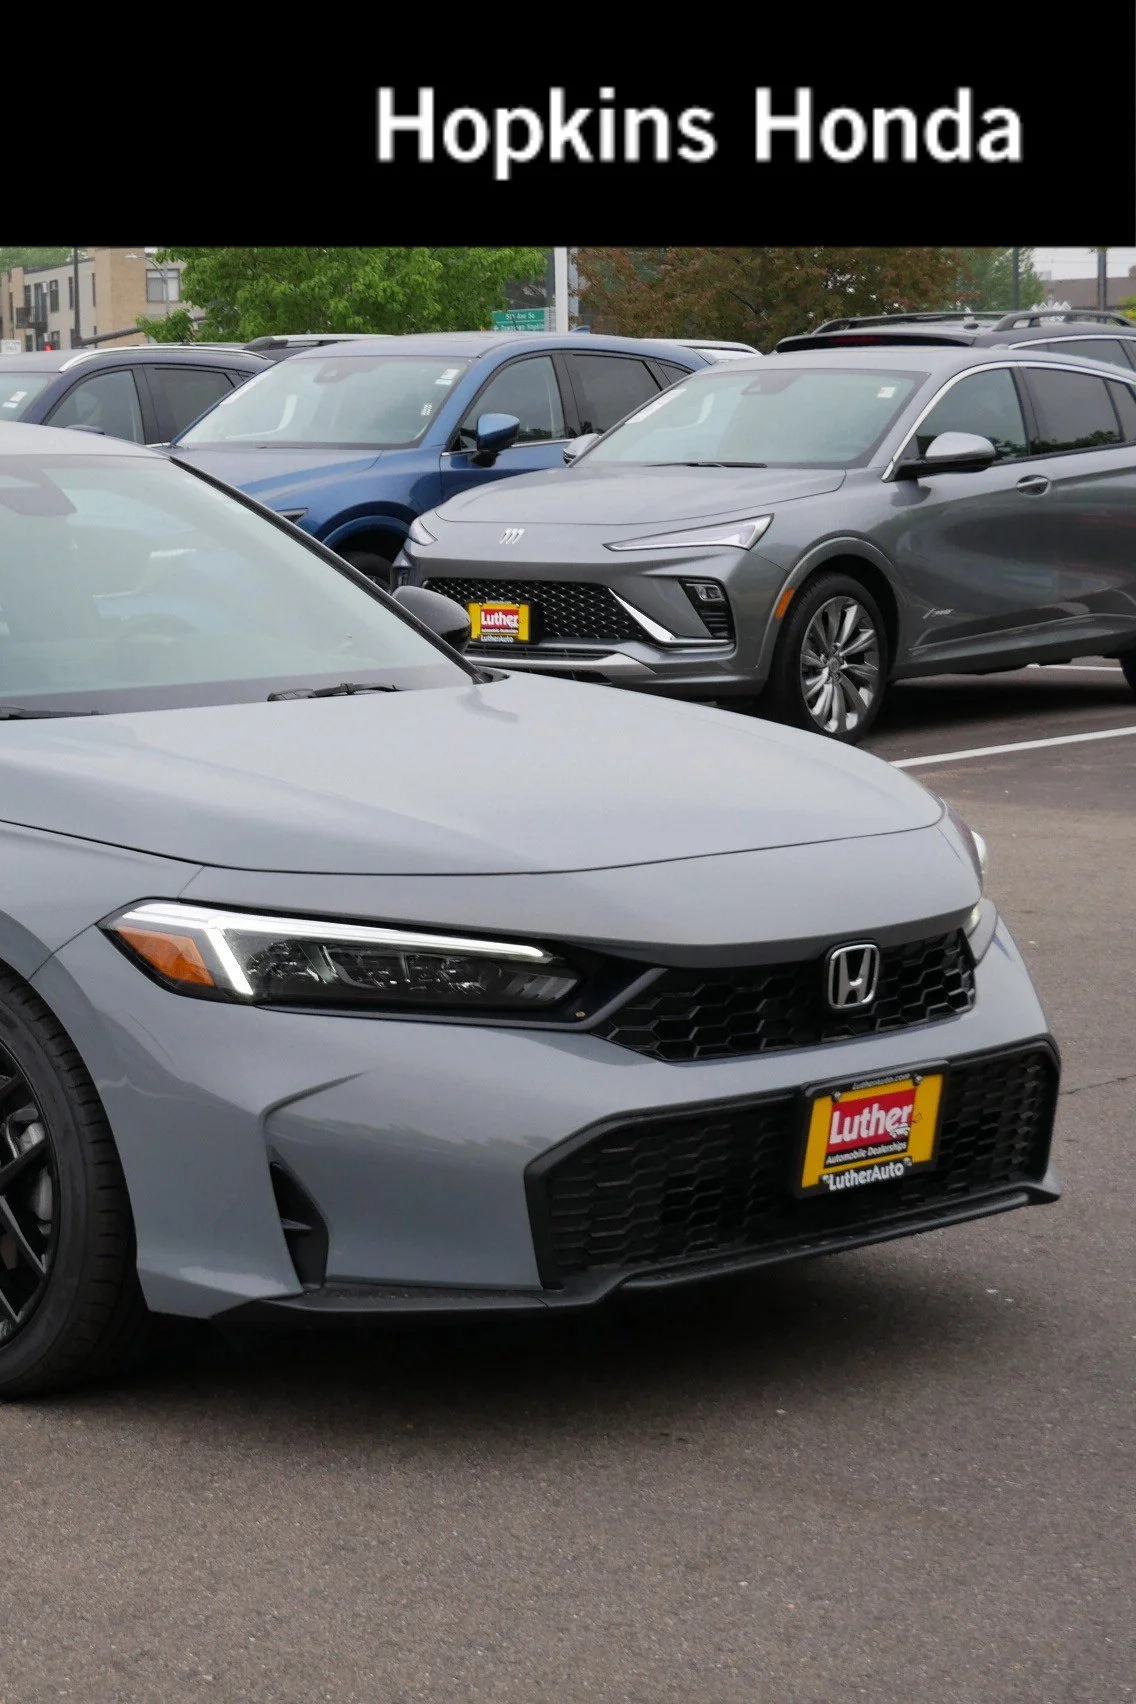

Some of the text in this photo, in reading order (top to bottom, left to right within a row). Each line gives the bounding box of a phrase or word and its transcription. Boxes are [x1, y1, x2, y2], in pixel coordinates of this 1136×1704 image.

[481, 611, 519, 626] Luther
[829, 1103, 913, 1145] Luther
[827, 1161, 905, 1191] LutherAuto
